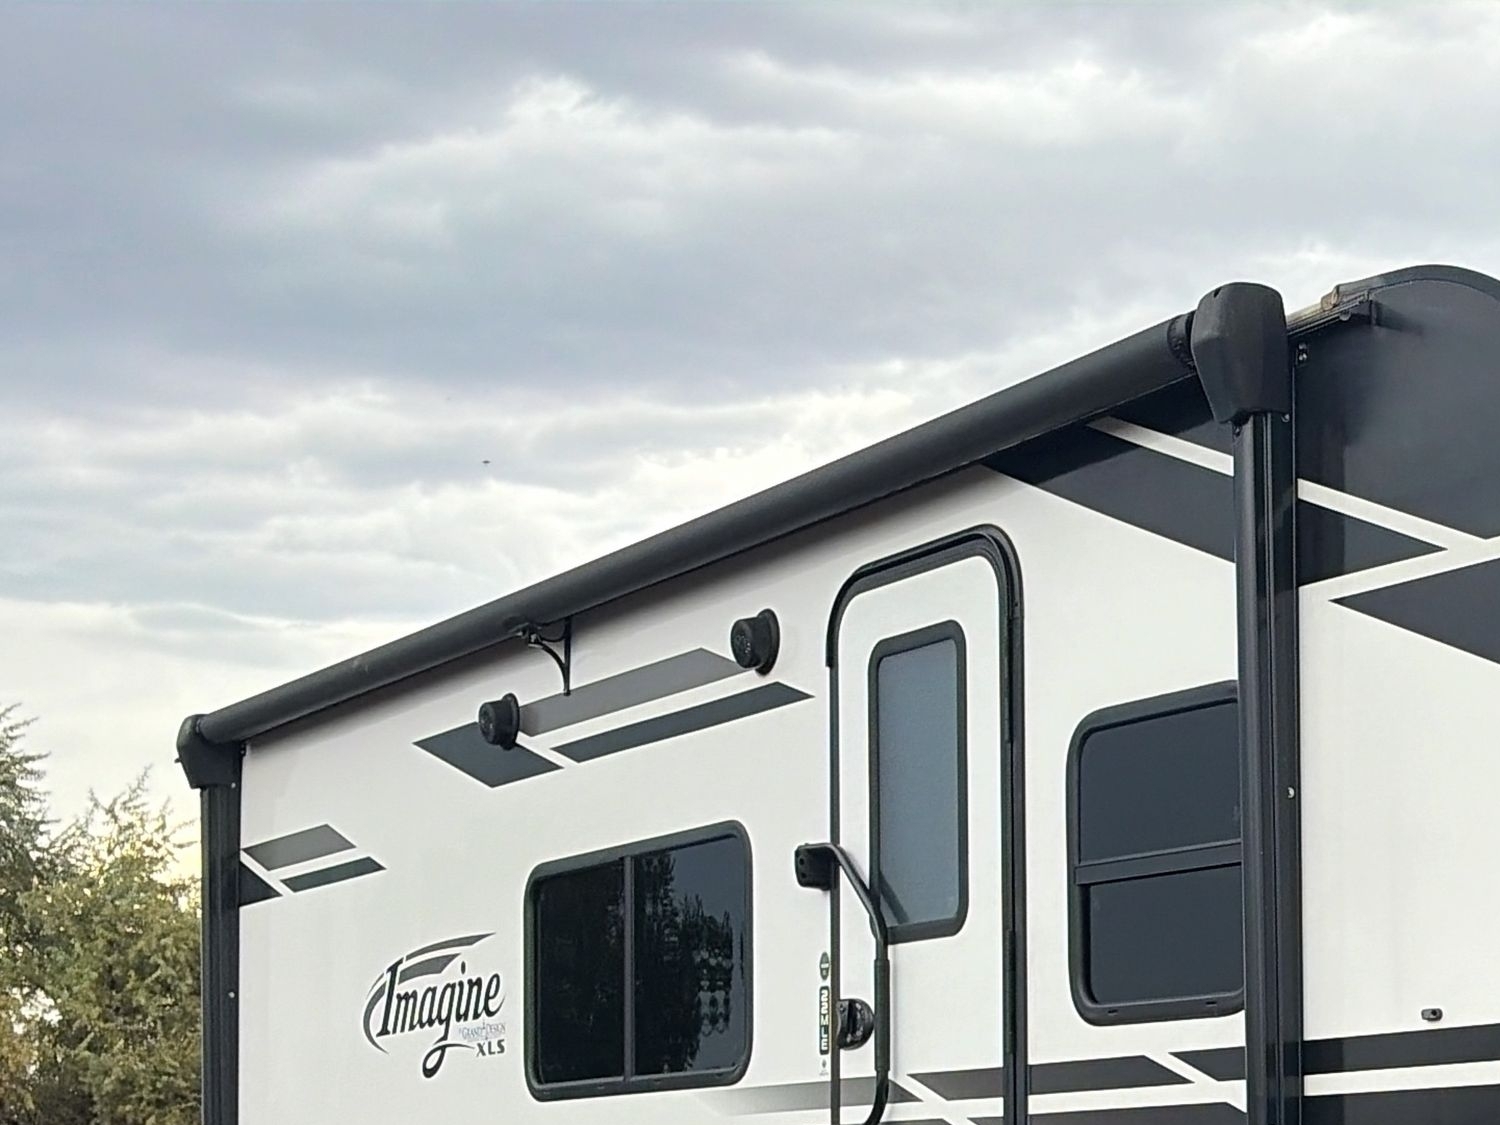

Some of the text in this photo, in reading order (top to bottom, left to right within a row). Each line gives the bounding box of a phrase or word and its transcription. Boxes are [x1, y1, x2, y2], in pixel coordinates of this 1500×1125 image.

[375, 957, 506, 1079] Imagine
[476, 1039, 505, 1057] XLS
[821, 989, 829, 1050] 22MLE
